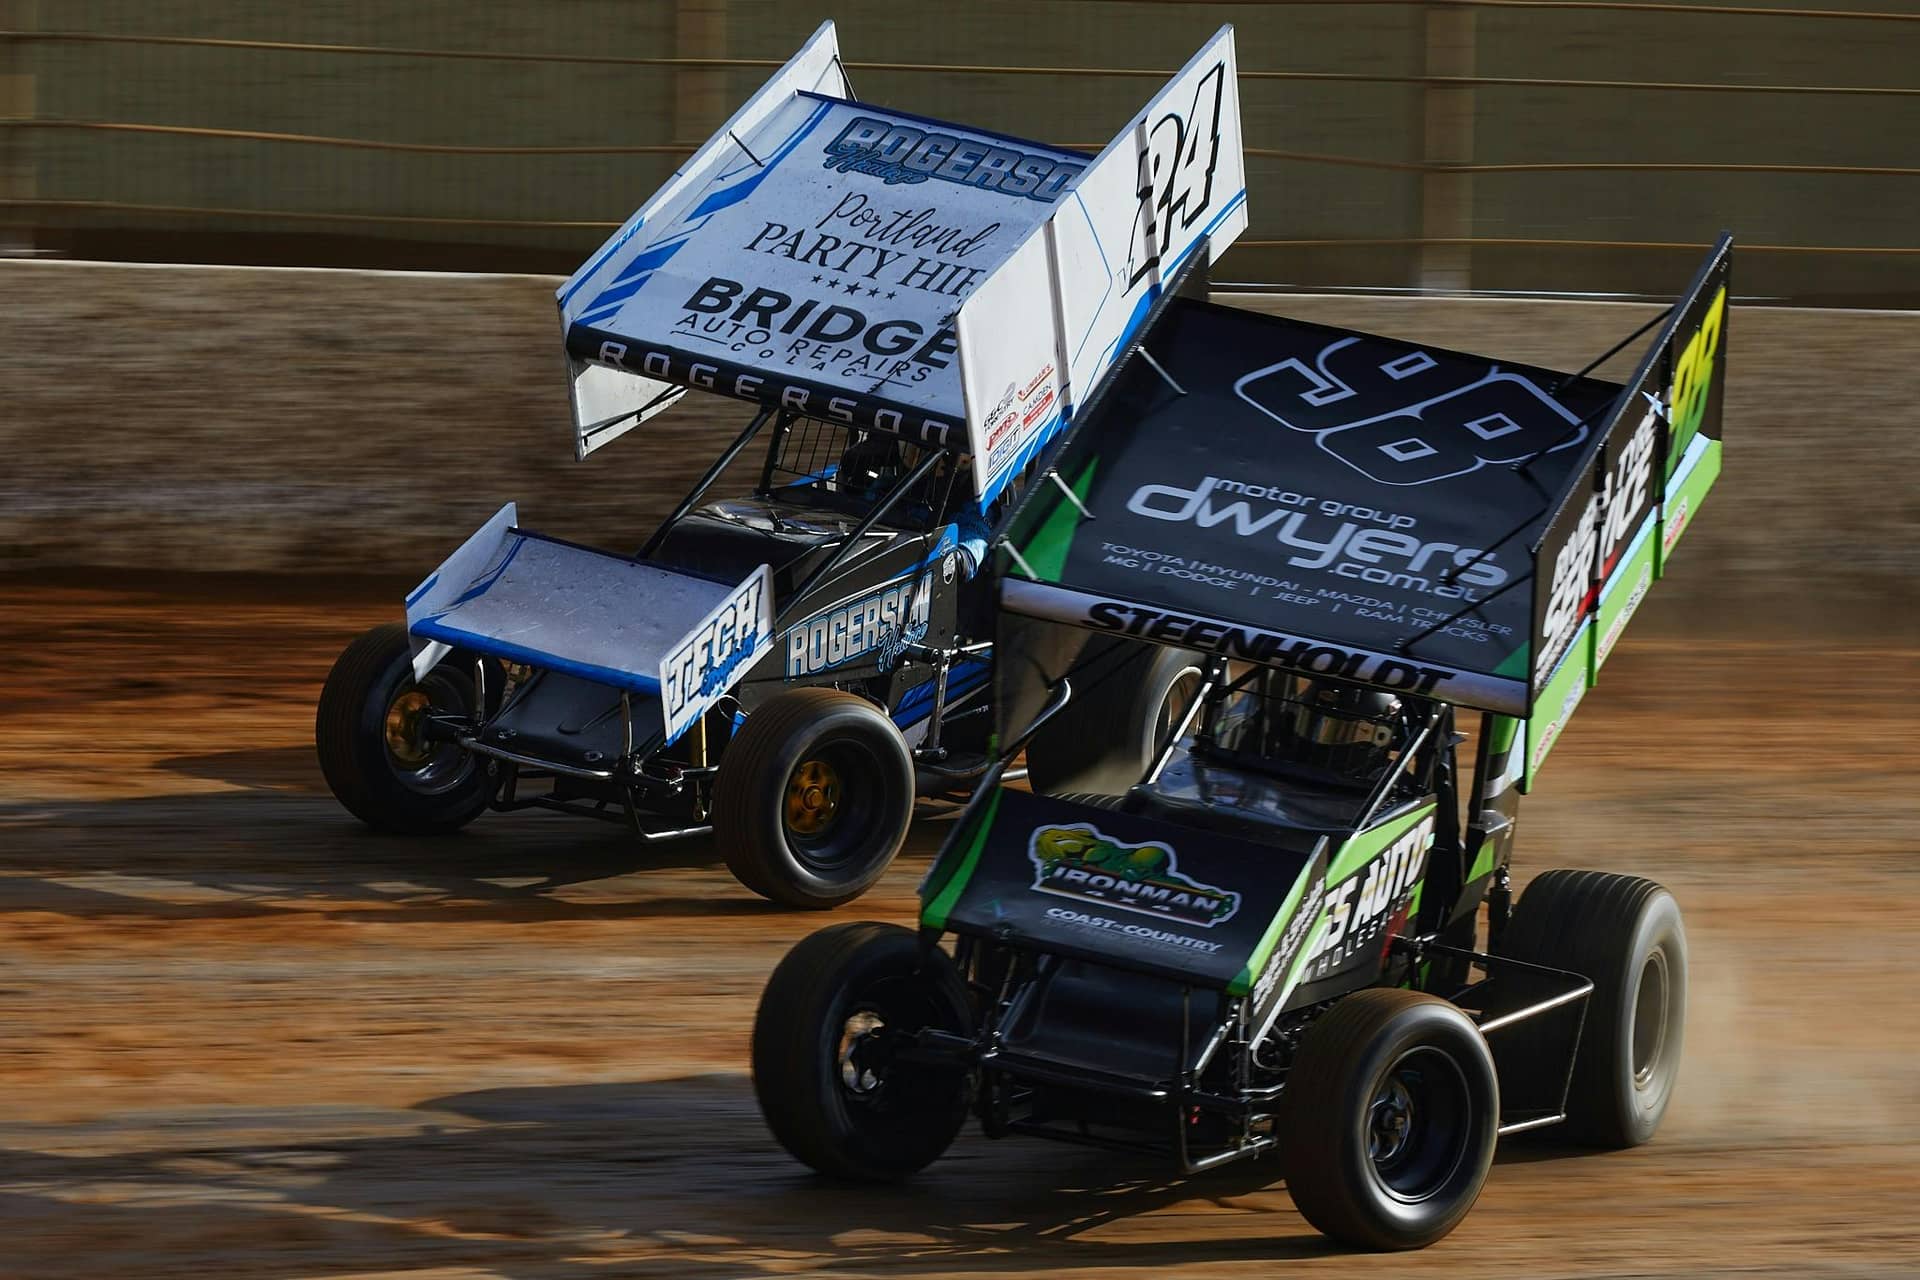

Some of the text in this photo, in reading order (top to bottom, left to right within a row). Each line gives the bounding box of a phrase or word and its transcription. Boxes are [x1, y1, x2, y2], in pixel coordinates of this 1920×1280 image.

[823, 118, 1086, 203] ROGERSO
[1122, 60, 1224, 297] 24
[743, 222, 907, 280] PARTY
[676, 312, 936, 383] AUTO REPAIRS
[682, 276, 958, 370] BRIDGE
[731, 342, 858, 378] COLAC
[1126, 476, 1510, 587] dwyers
[1212, 478, 1418, 531] motor group
[1102, 542, 1185, 566] TOYOTA
[1201, 563, 1300, 591] HYUNDAI
[1316, 588, 1395, 610] MAZDA
[1103, 556, 1140, 568] MG
[1158, 566, 1239, 590] DODGE
[1272, 592, 1321, 605] JEEP
[1355, 607, 1404, 623] RAM
[668, 575, 764, 720] TECH
[785, 571, 934, 682] ROGERSON
[1081, 602, 1456, 698] STEENHOLDT
[1052, 866, 1222, 912] IRONMAN
[1350, 815, 1434, 934] AUTO
[1046, 907, 1116, 929] COAST
[1123, 924, 1225, 952] COUNTRY
